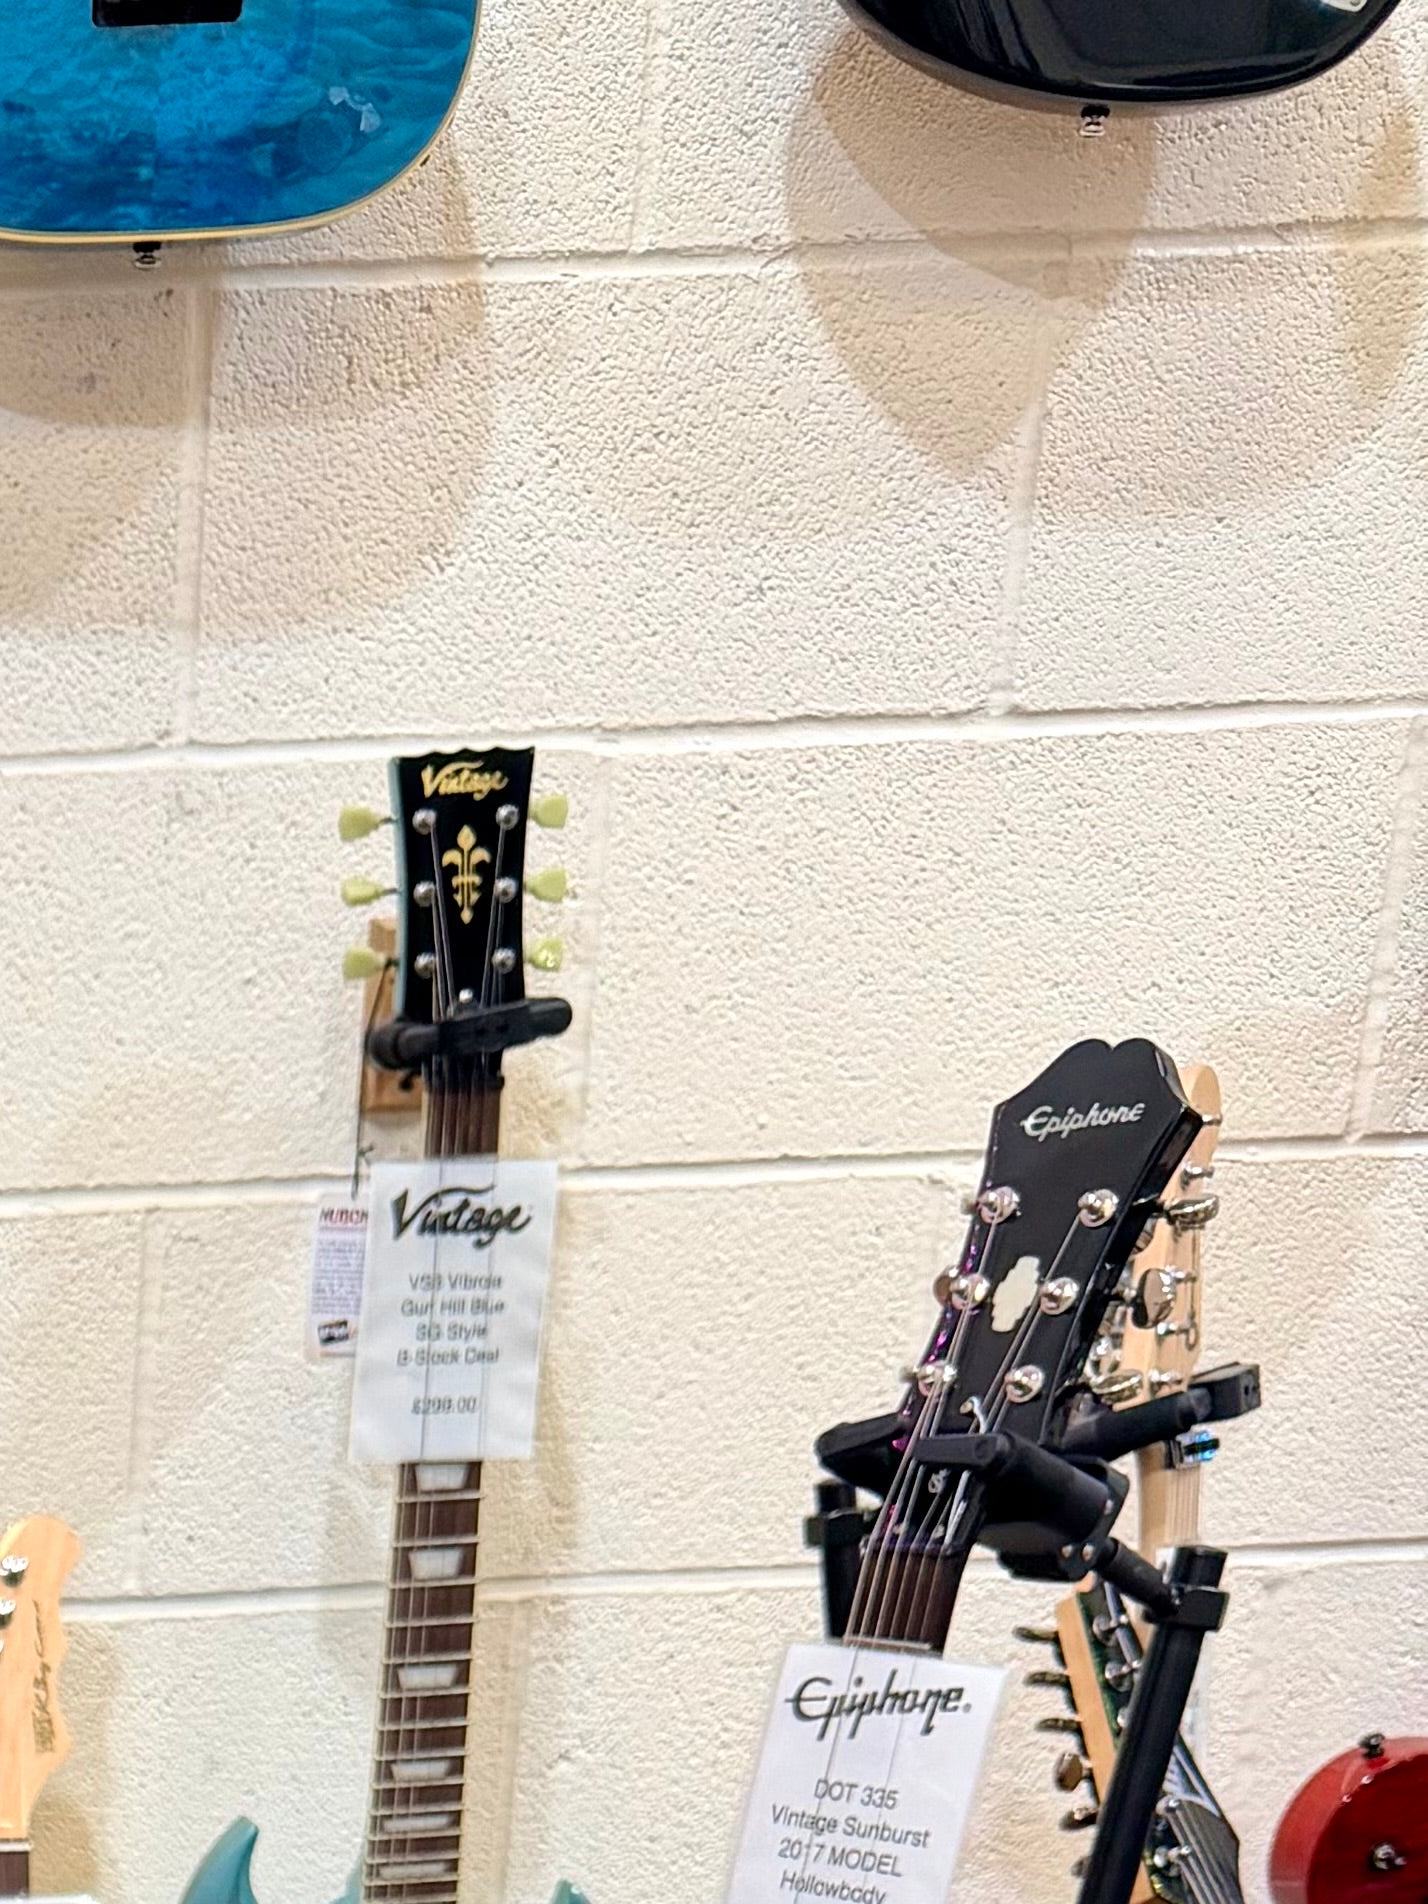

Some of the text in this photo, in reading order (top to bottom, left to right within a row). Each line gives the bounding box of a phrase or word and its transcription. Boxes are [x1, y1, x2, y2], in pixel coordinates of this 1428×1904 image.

[421, 760, 509, 800] Vintage
[1019, 1101, 1145, 1142] Epiphone
[390, 1184, 533, 1249] Vintage
[813, 1778, 899, 1810] DOT 335
[771, 1804, 932, 1849] Vintage Sunburst
[827, 1847, 903, 1878] MODEL
